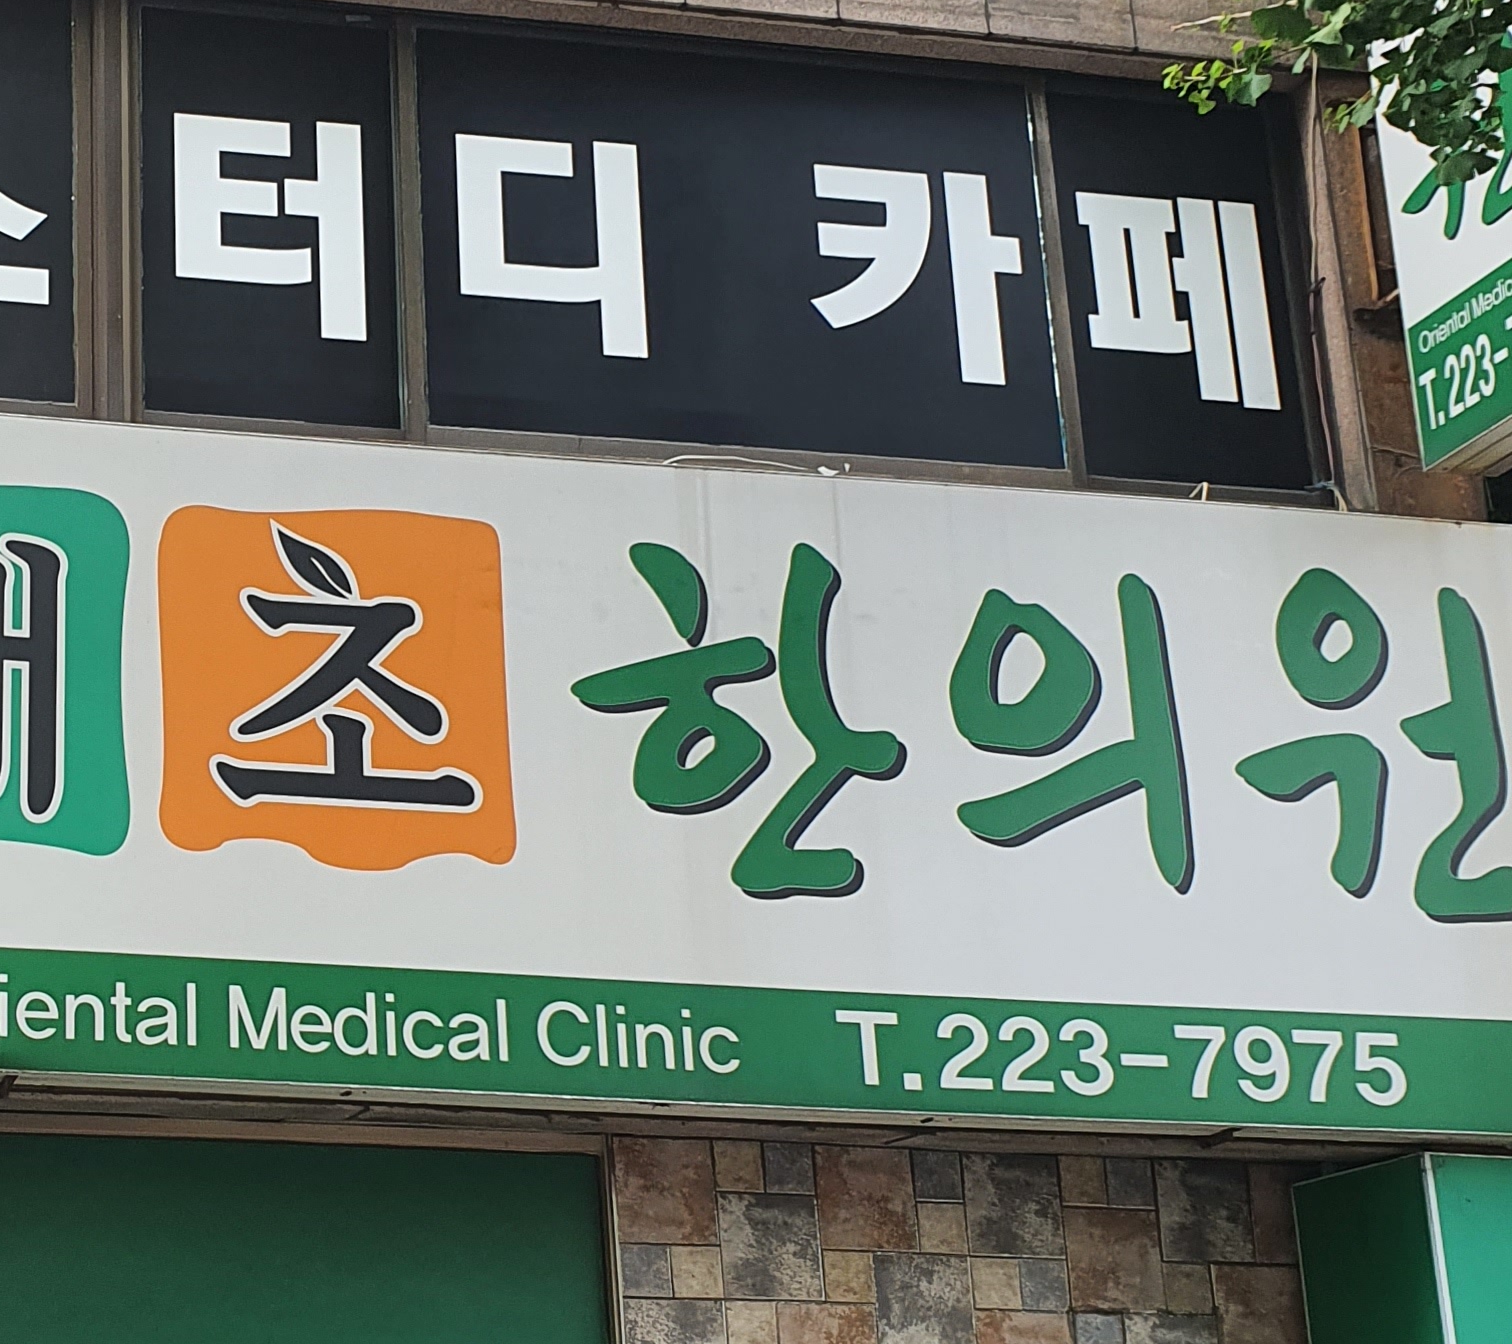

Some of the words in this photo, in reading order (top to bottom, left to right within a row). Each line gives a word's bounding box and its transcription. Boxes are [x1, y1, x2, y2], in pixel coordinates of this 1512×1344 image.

[809, 162, 1282, 411] 카페
[1418, 301, 1471, 353] Oriental
[1418, 315, 1512, 430] T.223-
[227, 984, 508, 1062] Medical
[535, 1001, 742, 1076] Clinic
[835, 1009, 1408, 1107] T.223-7975
